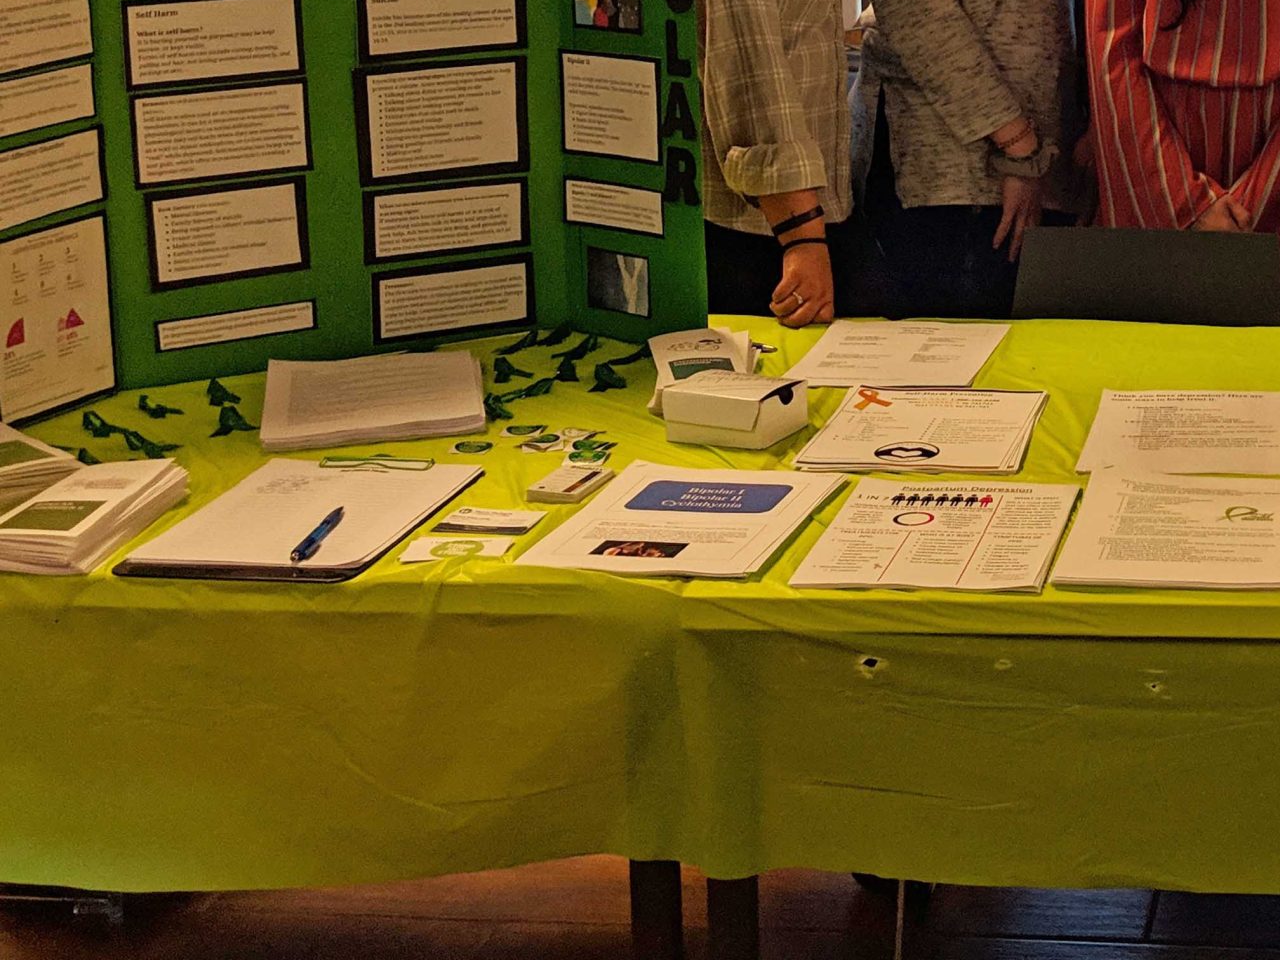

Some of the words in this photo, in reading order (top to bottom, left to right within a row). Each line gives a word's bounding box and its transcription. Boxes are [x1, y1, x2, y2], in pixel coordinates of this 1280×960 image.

[687, 487, 737, 495] Bipolar
[902, 485, 970, 493] Postpartum
[971, 486, 1033, 494] Depression
[680, 494, 728, 502] Bipolar
[660, 499, 743, 510] Cyclothymia
